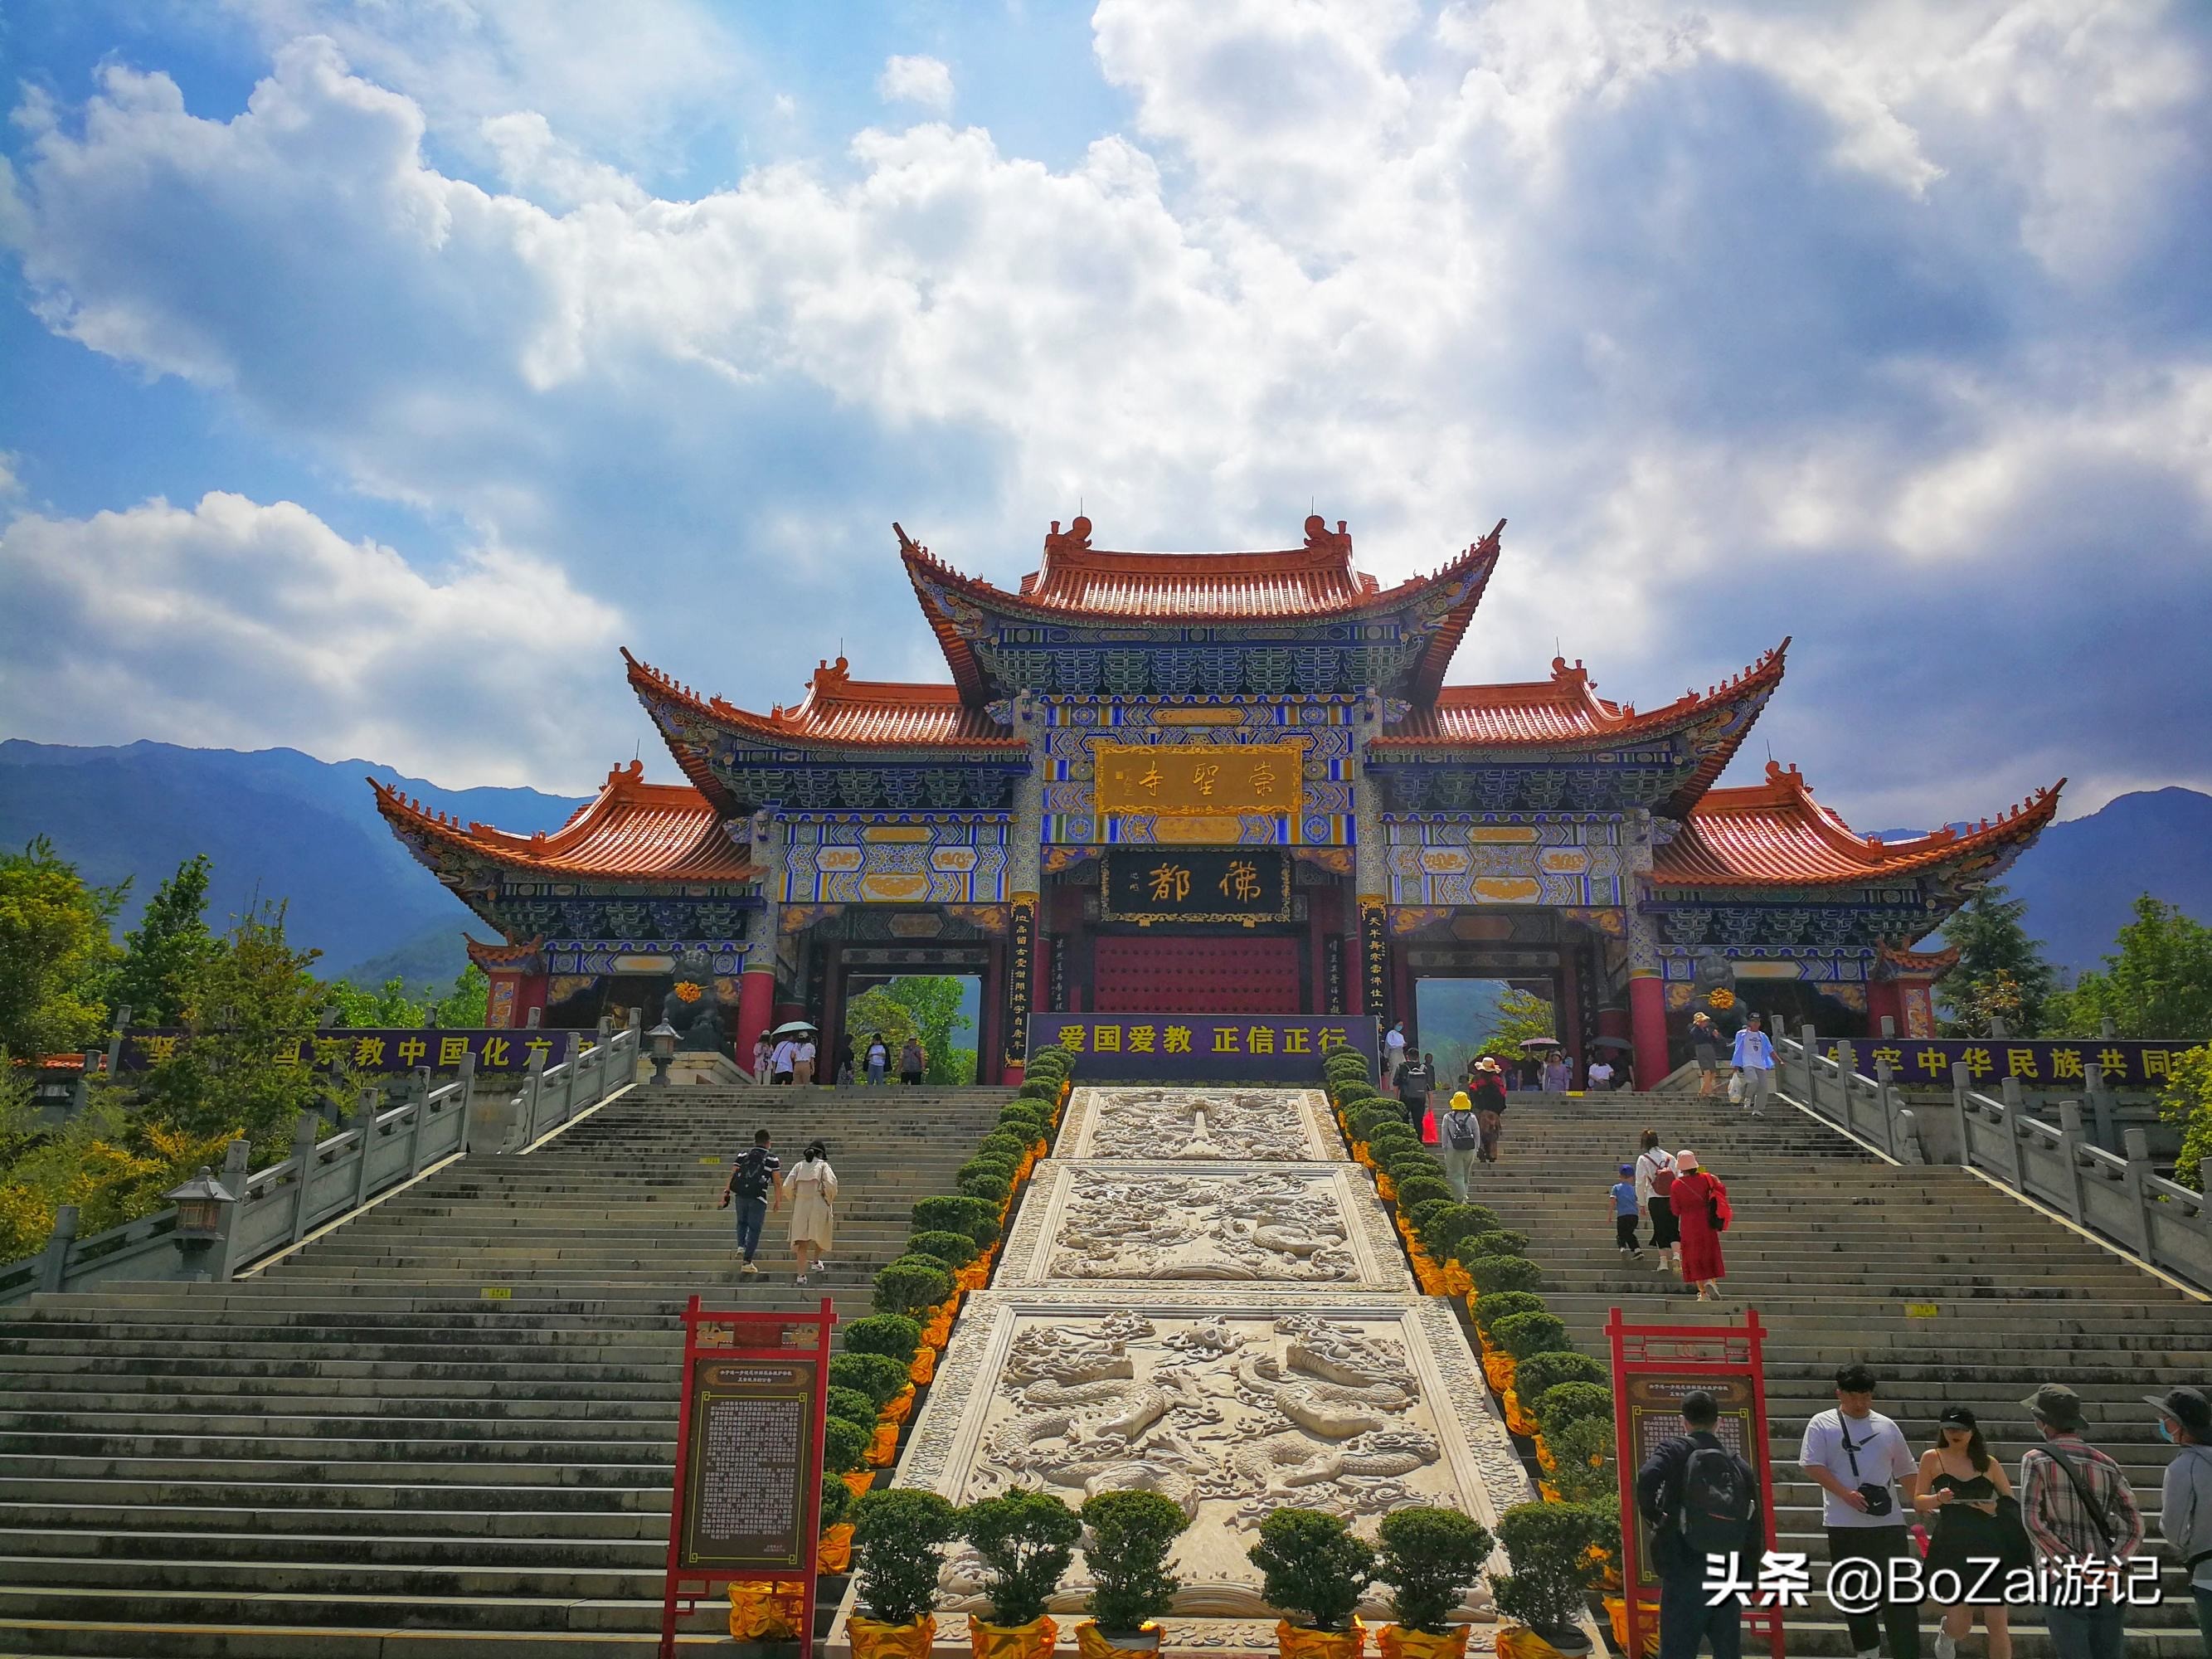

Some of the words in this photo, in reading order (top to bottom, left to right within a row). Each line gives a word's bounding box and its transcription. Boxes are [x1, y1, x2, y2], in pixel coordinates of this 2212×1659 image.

[1057, 1024, 1193, 1053] 爱国爱教
[1211, 1026, 1348, 1054] 正信正行
